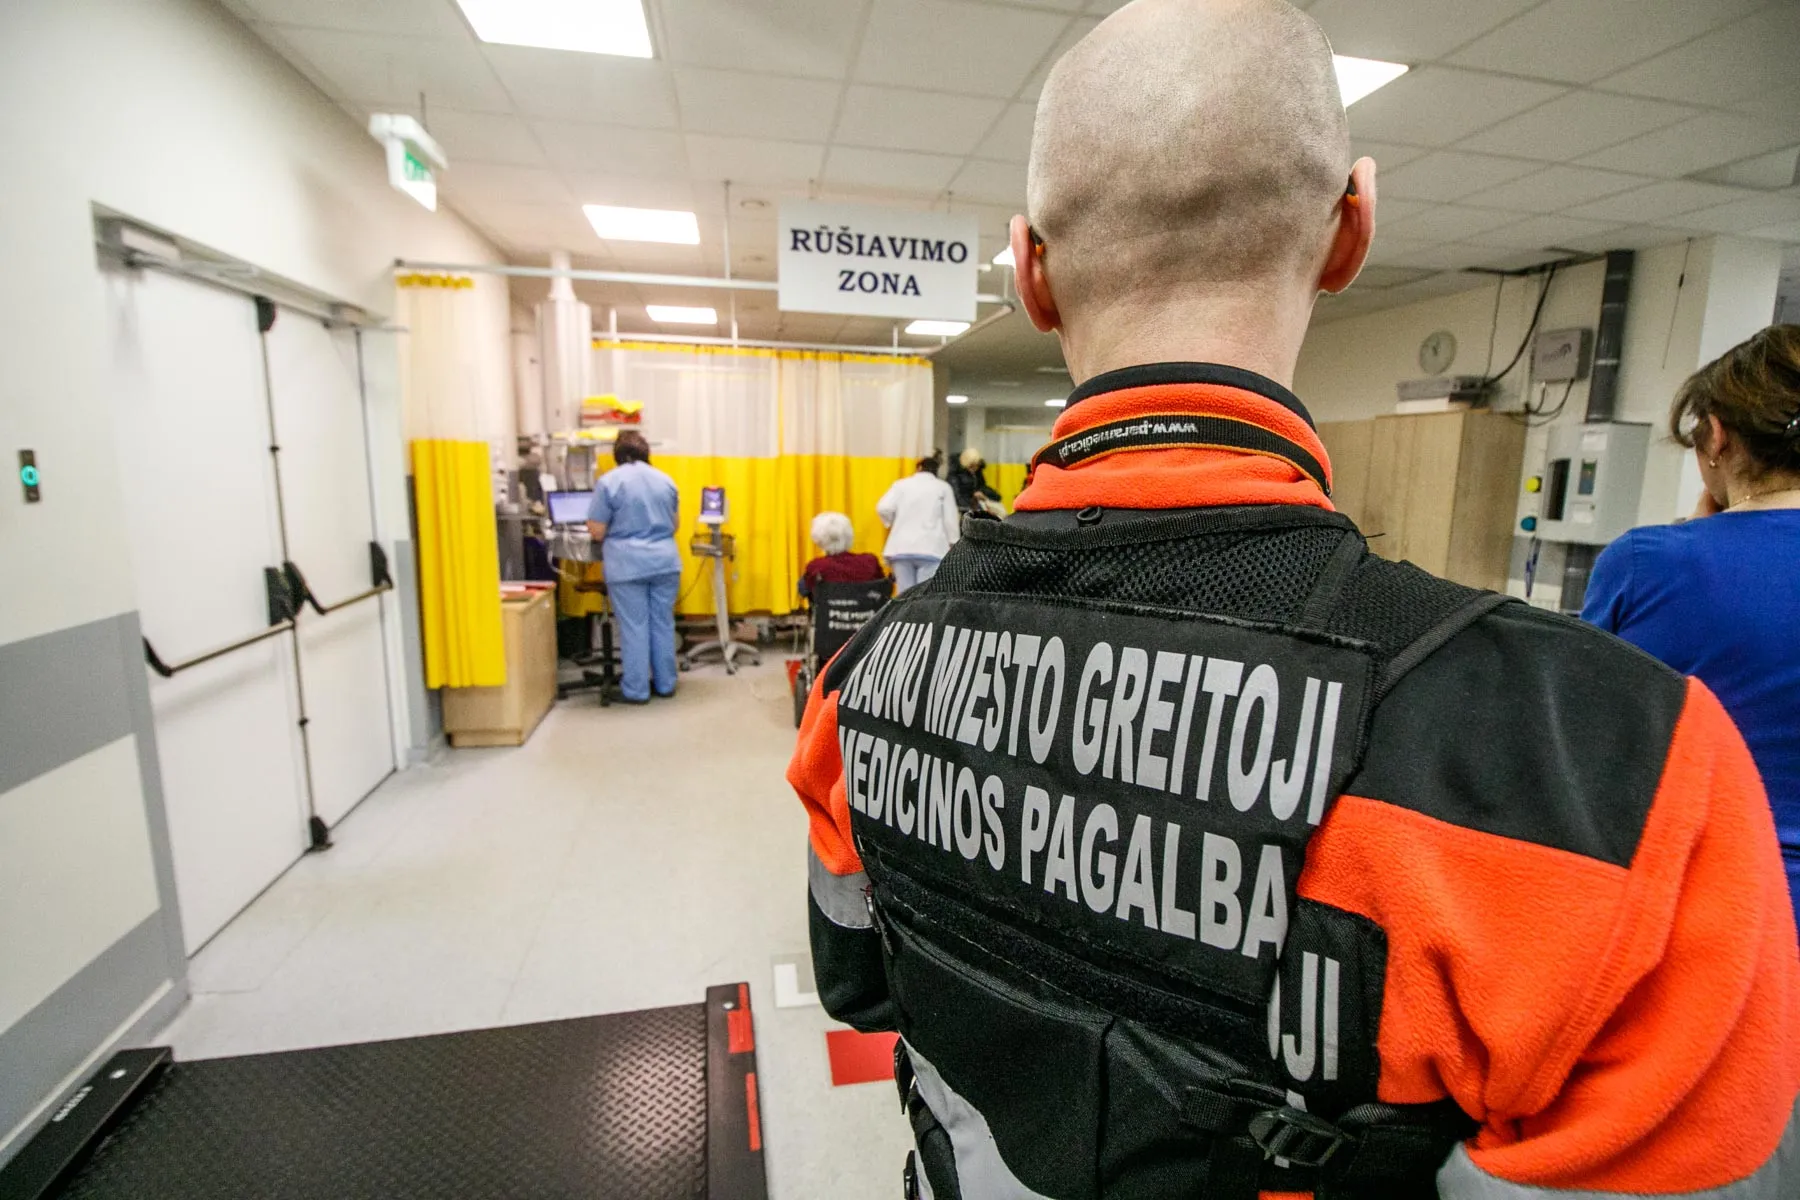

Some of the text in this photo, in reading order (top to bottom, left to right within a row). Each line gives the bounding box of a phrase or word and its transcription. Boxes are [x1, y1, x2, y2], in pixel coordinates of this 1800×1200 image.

[790, 224, 969, 264] RŪŠIAVIMO
[838, 270, 922, 296] ZONA
[1058, 420, 1198, 462] www.paramedica.pl
[924, 625, 1066, 765] MIESTO
[1072, 641, 1343, 826] GREITOJI
[1021, 784, 1288, 959] PAGALBA
